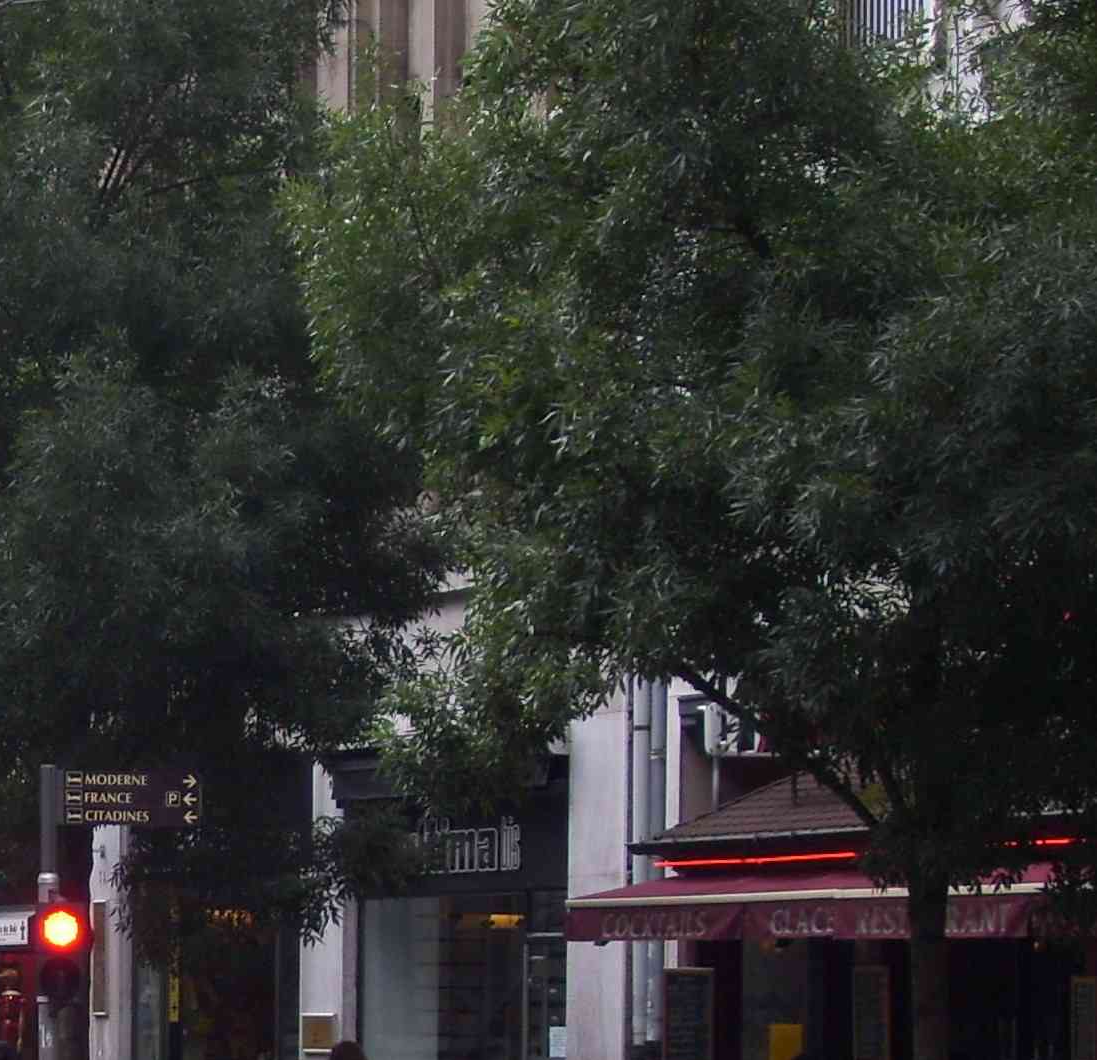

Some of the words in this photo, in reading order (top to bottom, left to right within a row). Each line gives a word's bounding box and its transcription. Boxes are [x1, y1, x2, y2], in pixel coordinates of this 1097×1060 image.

[85, 774, 149, 786] MODERNE
[85, 791, 134, 803] FRANCE
[85, 809, 150, 822] CITADINES
[600, 911, 707, 938] COCKTAILS
